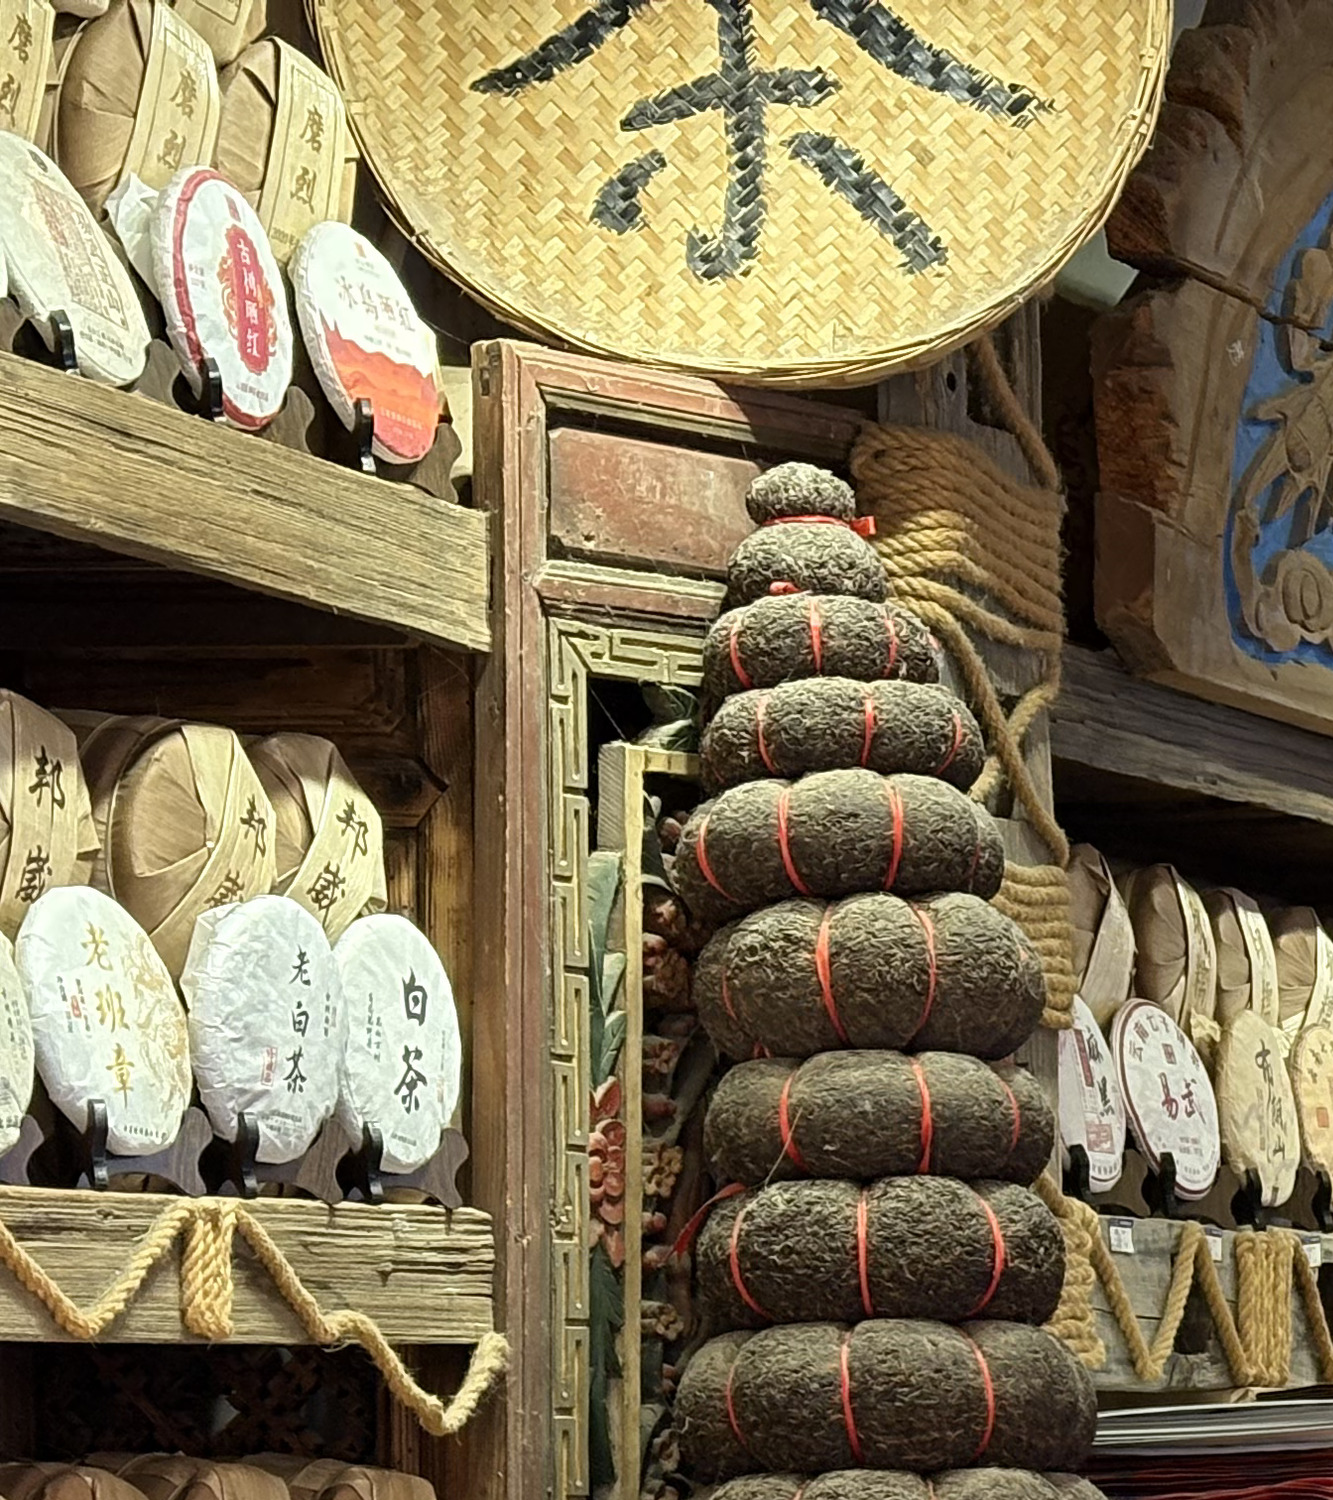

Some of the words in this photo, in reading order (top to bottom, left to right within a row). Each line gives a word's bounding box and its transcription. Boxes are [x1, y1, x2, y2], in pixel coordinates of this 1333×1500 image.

[80, 920, 135, 1110] 老班章
[282, 944, 312, 1094] 老白茶
[393, 966, 429, 1115] 白茶
